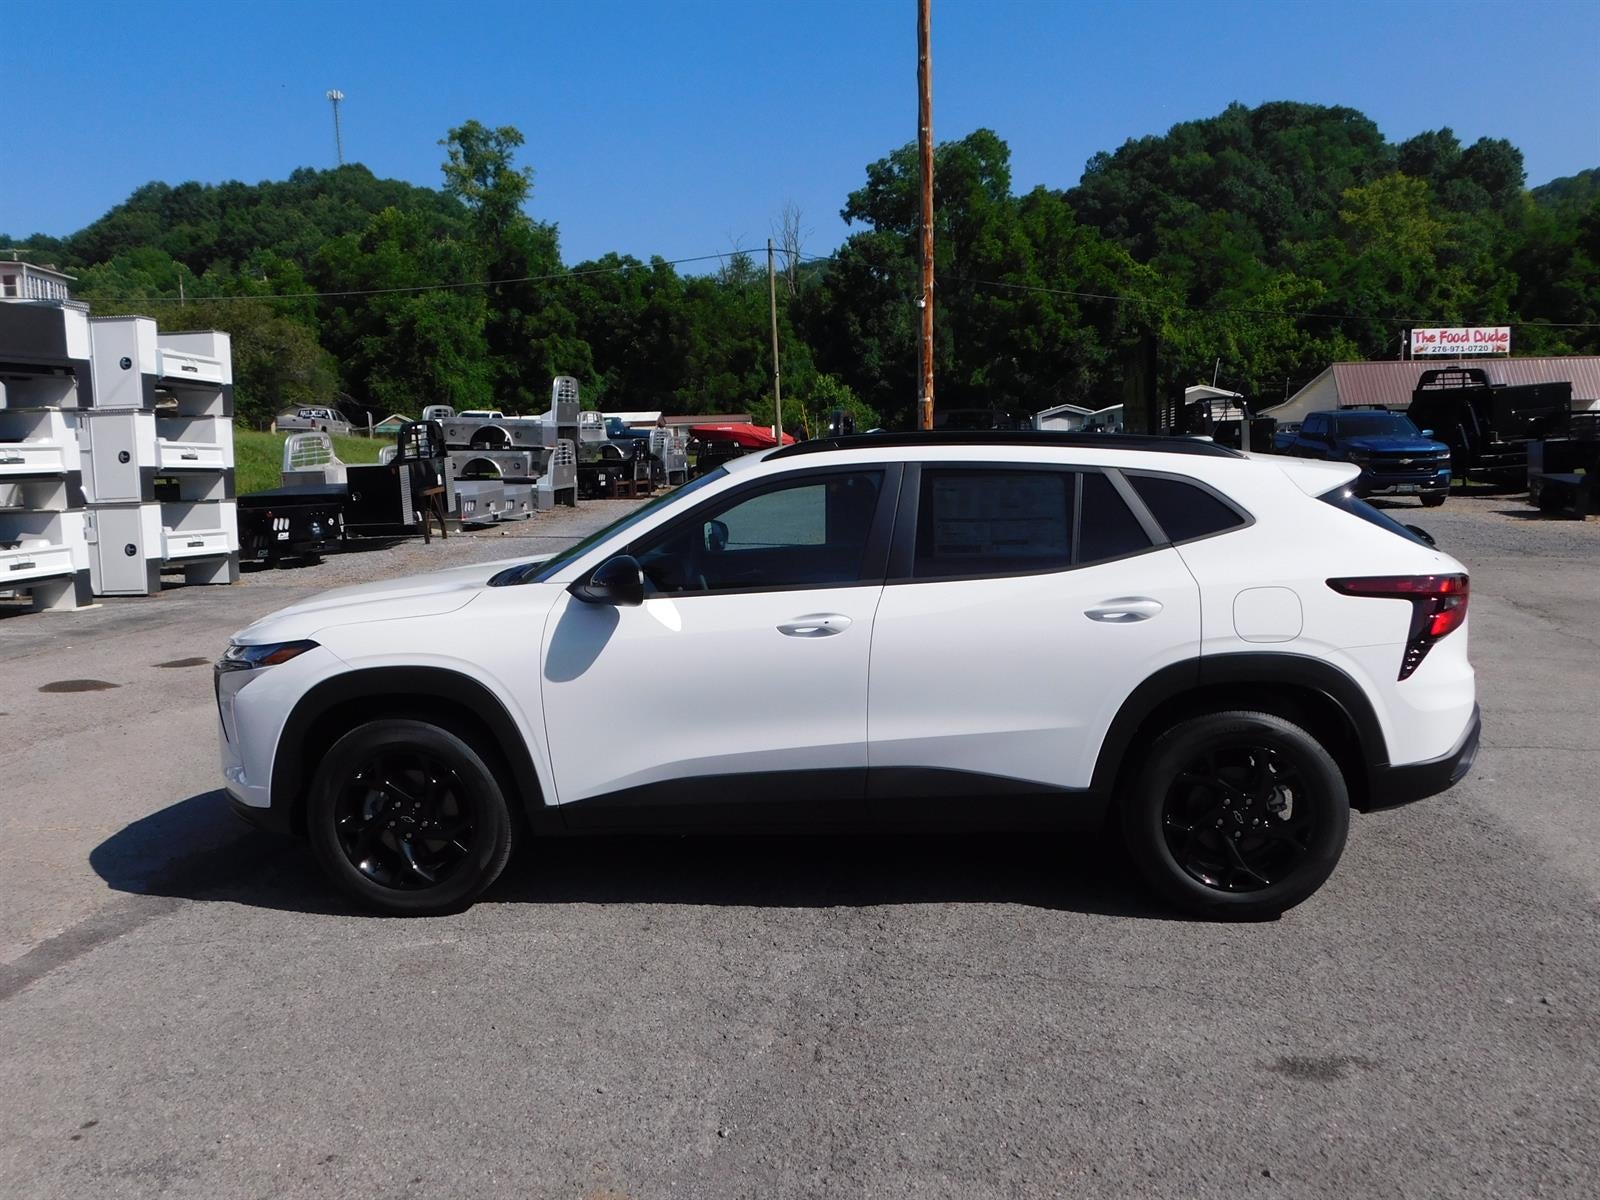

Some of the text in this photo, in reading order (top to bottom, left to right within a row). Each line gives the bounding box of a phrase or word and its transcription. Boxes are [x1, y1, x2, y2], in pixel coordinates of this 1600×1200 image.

[1413, 328, 1508, 344] The Food Dude
[1432, 345, 1489, 353] 276-971-0720
